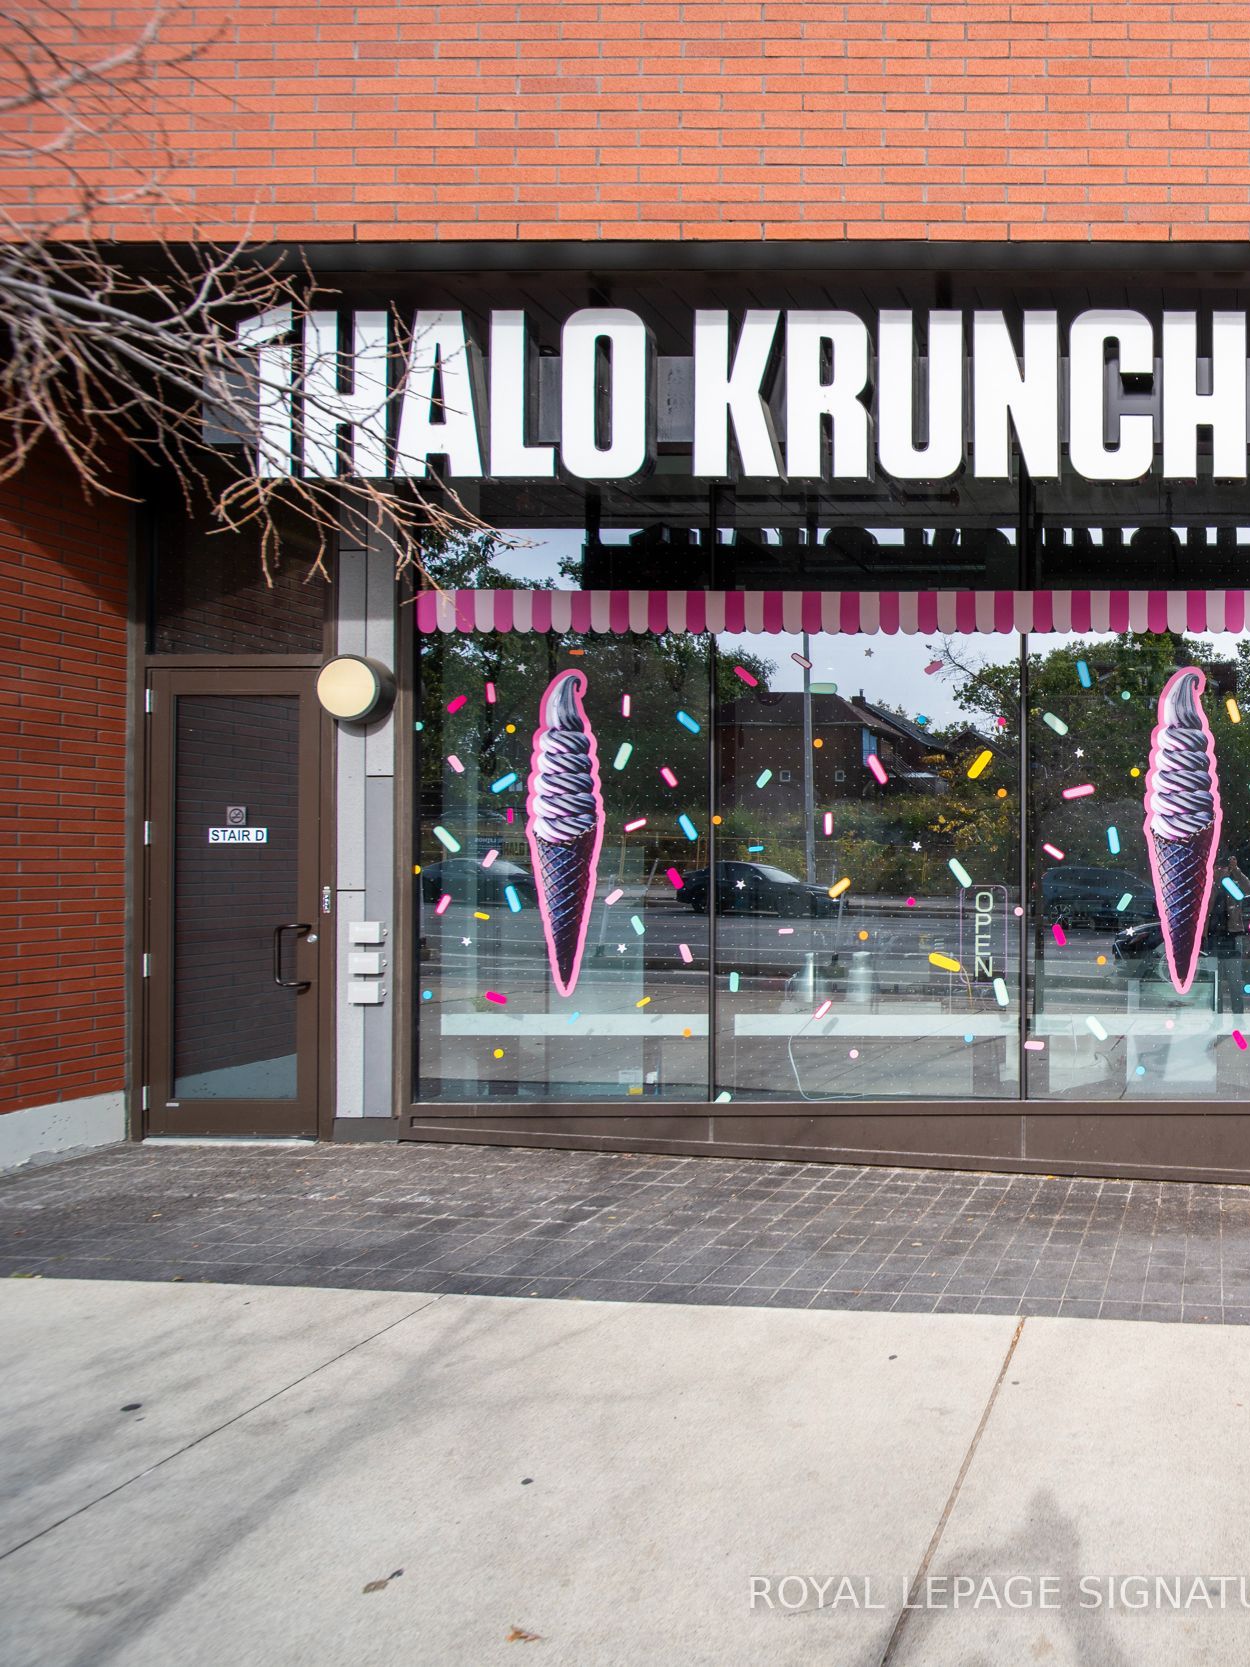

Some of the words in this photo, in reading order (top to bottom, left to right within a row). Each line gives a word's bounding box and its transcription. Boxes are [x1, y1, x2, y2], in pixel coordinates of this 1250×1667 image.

[694, 308, 1247, 479] KRUNCH
[211, 829, 251, 841] STAIR
[255, 829, 265, 841] D
[975, 891, 994, 978] OPEN
